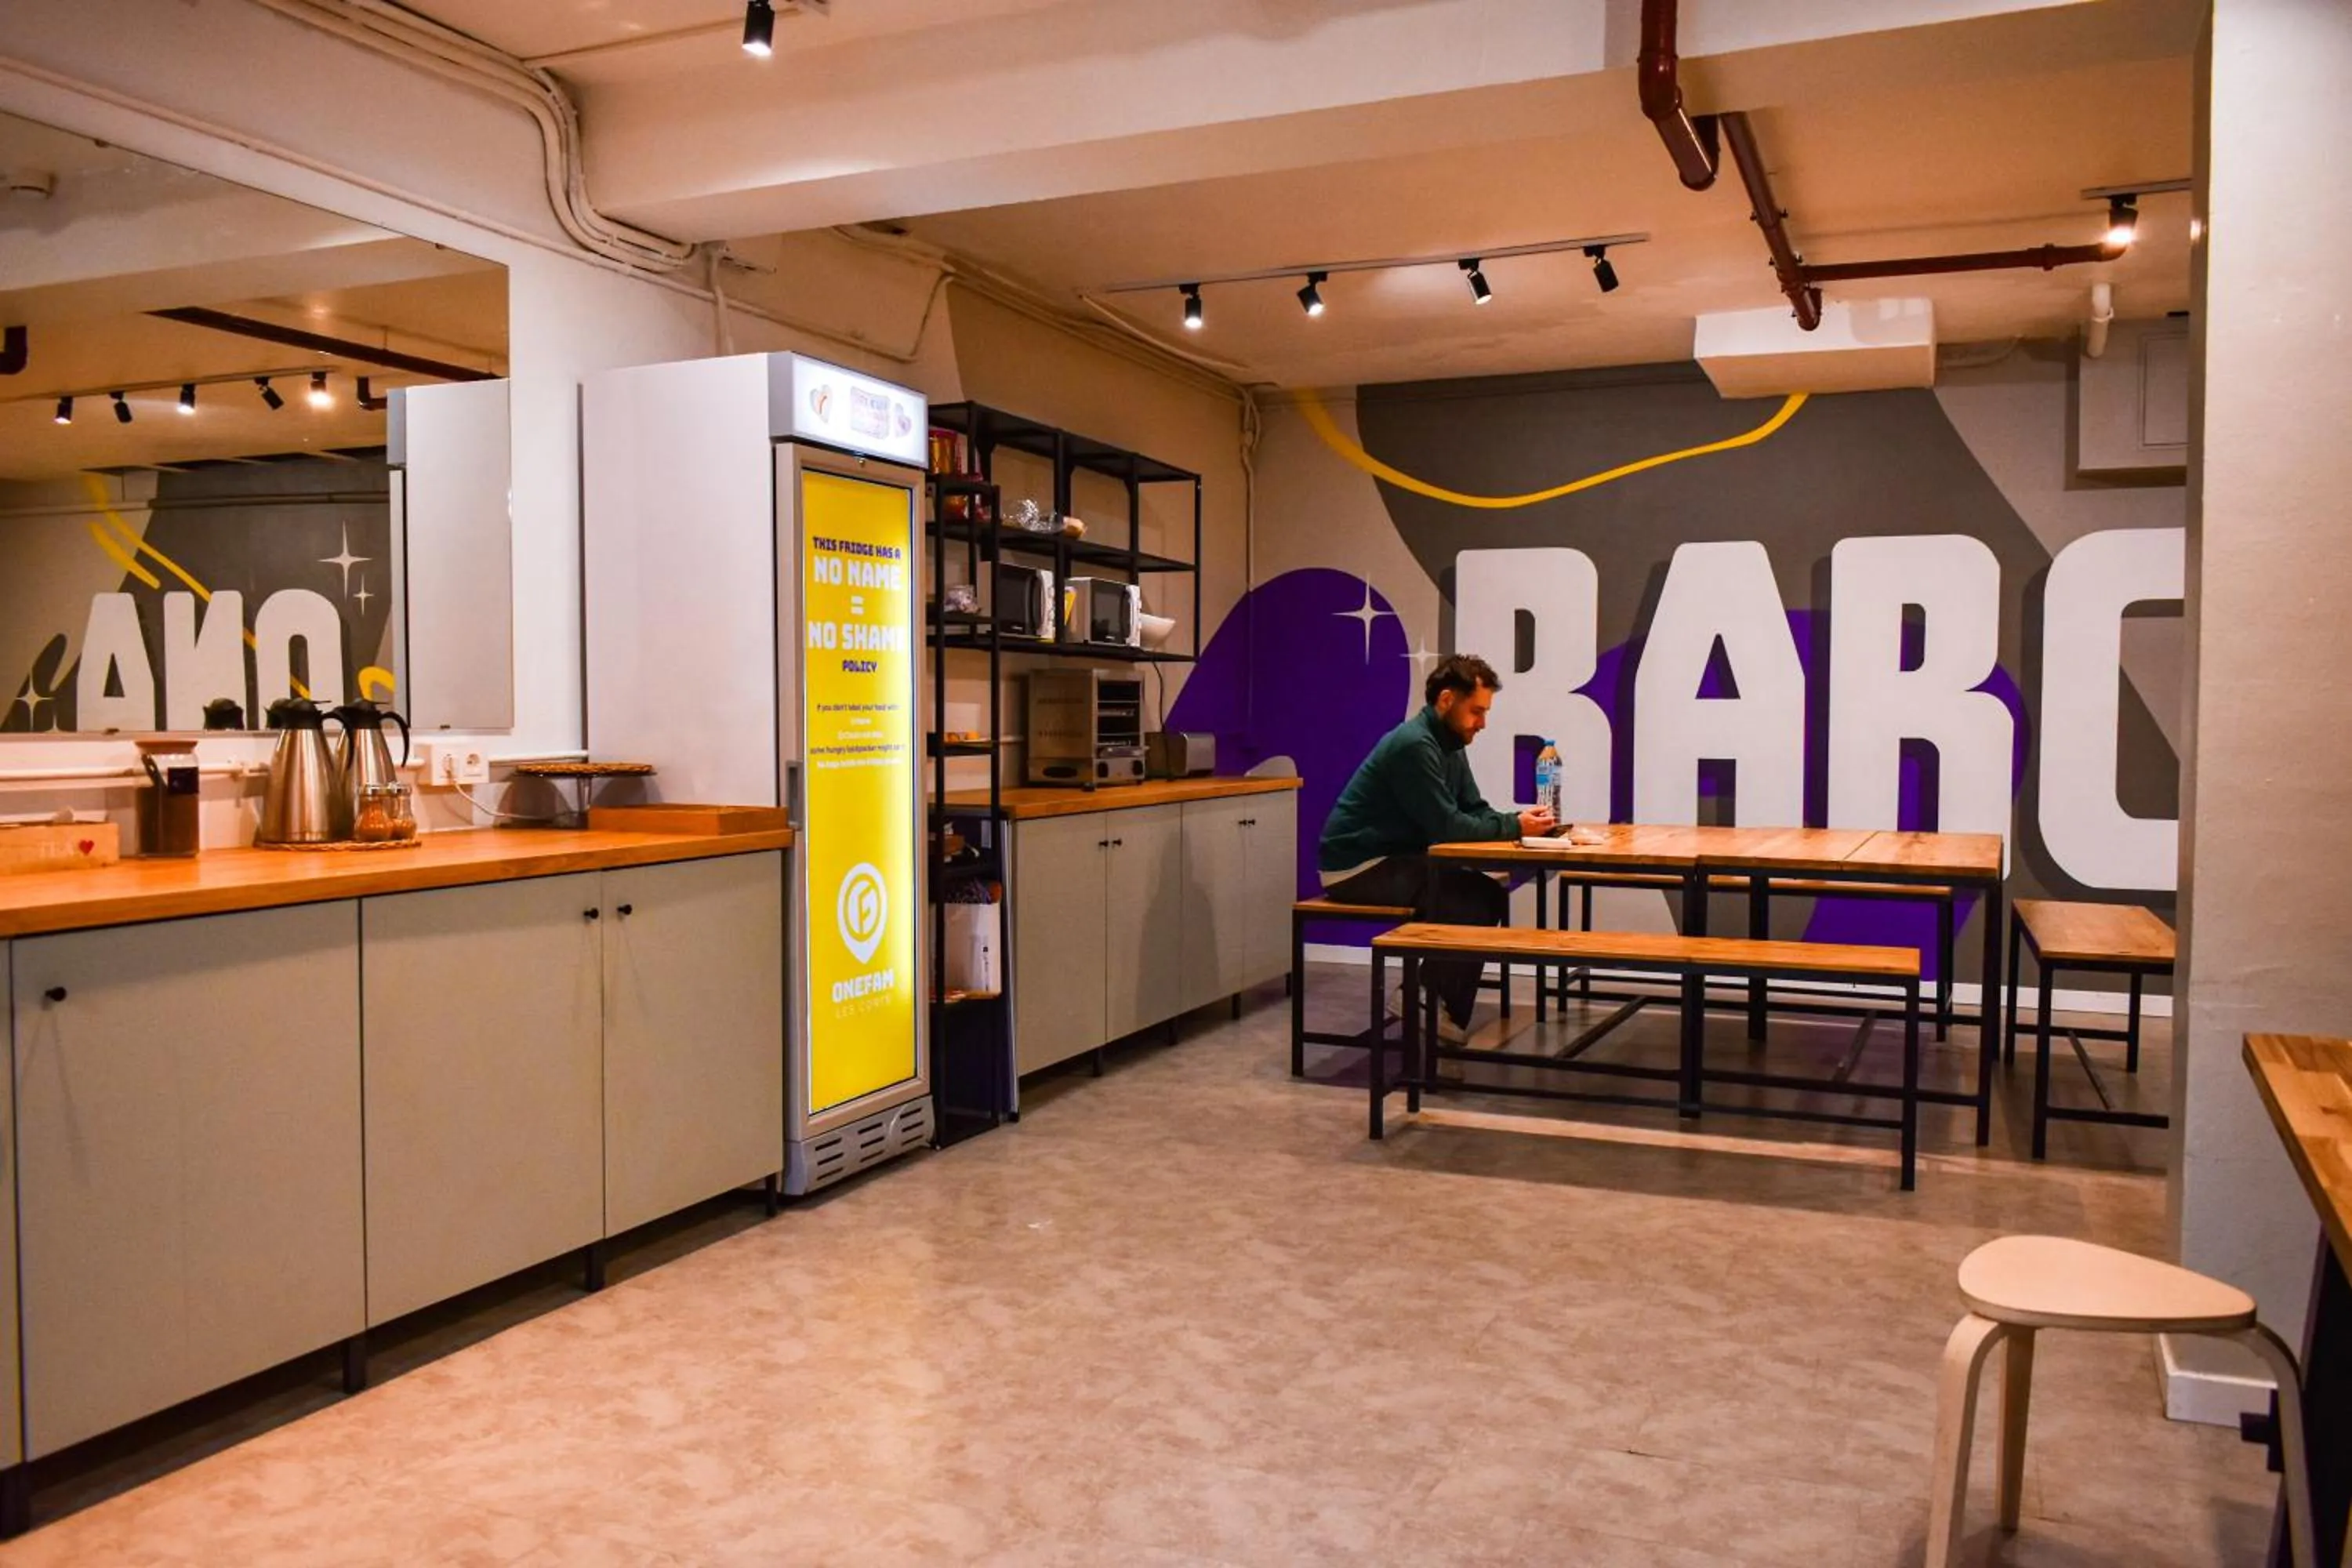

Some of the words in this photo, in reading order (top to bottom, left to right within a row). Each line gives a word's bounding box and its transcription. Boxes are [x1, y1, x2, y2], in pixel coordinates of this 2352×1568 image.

[813, 536, 837, 551] THIS
[839, 540, 873, 556] FRIDGE
[876, 546, 893, 558] HAS
[895, 548, 901, 559] A
[815, 555, 842, 585] NO
[848, 559, 902, 590] NAME
[808, 621, 837, 649] NO
[842, 659, 877, 672] POLICY
[832, 969, 894, 1003] ONEFAM
